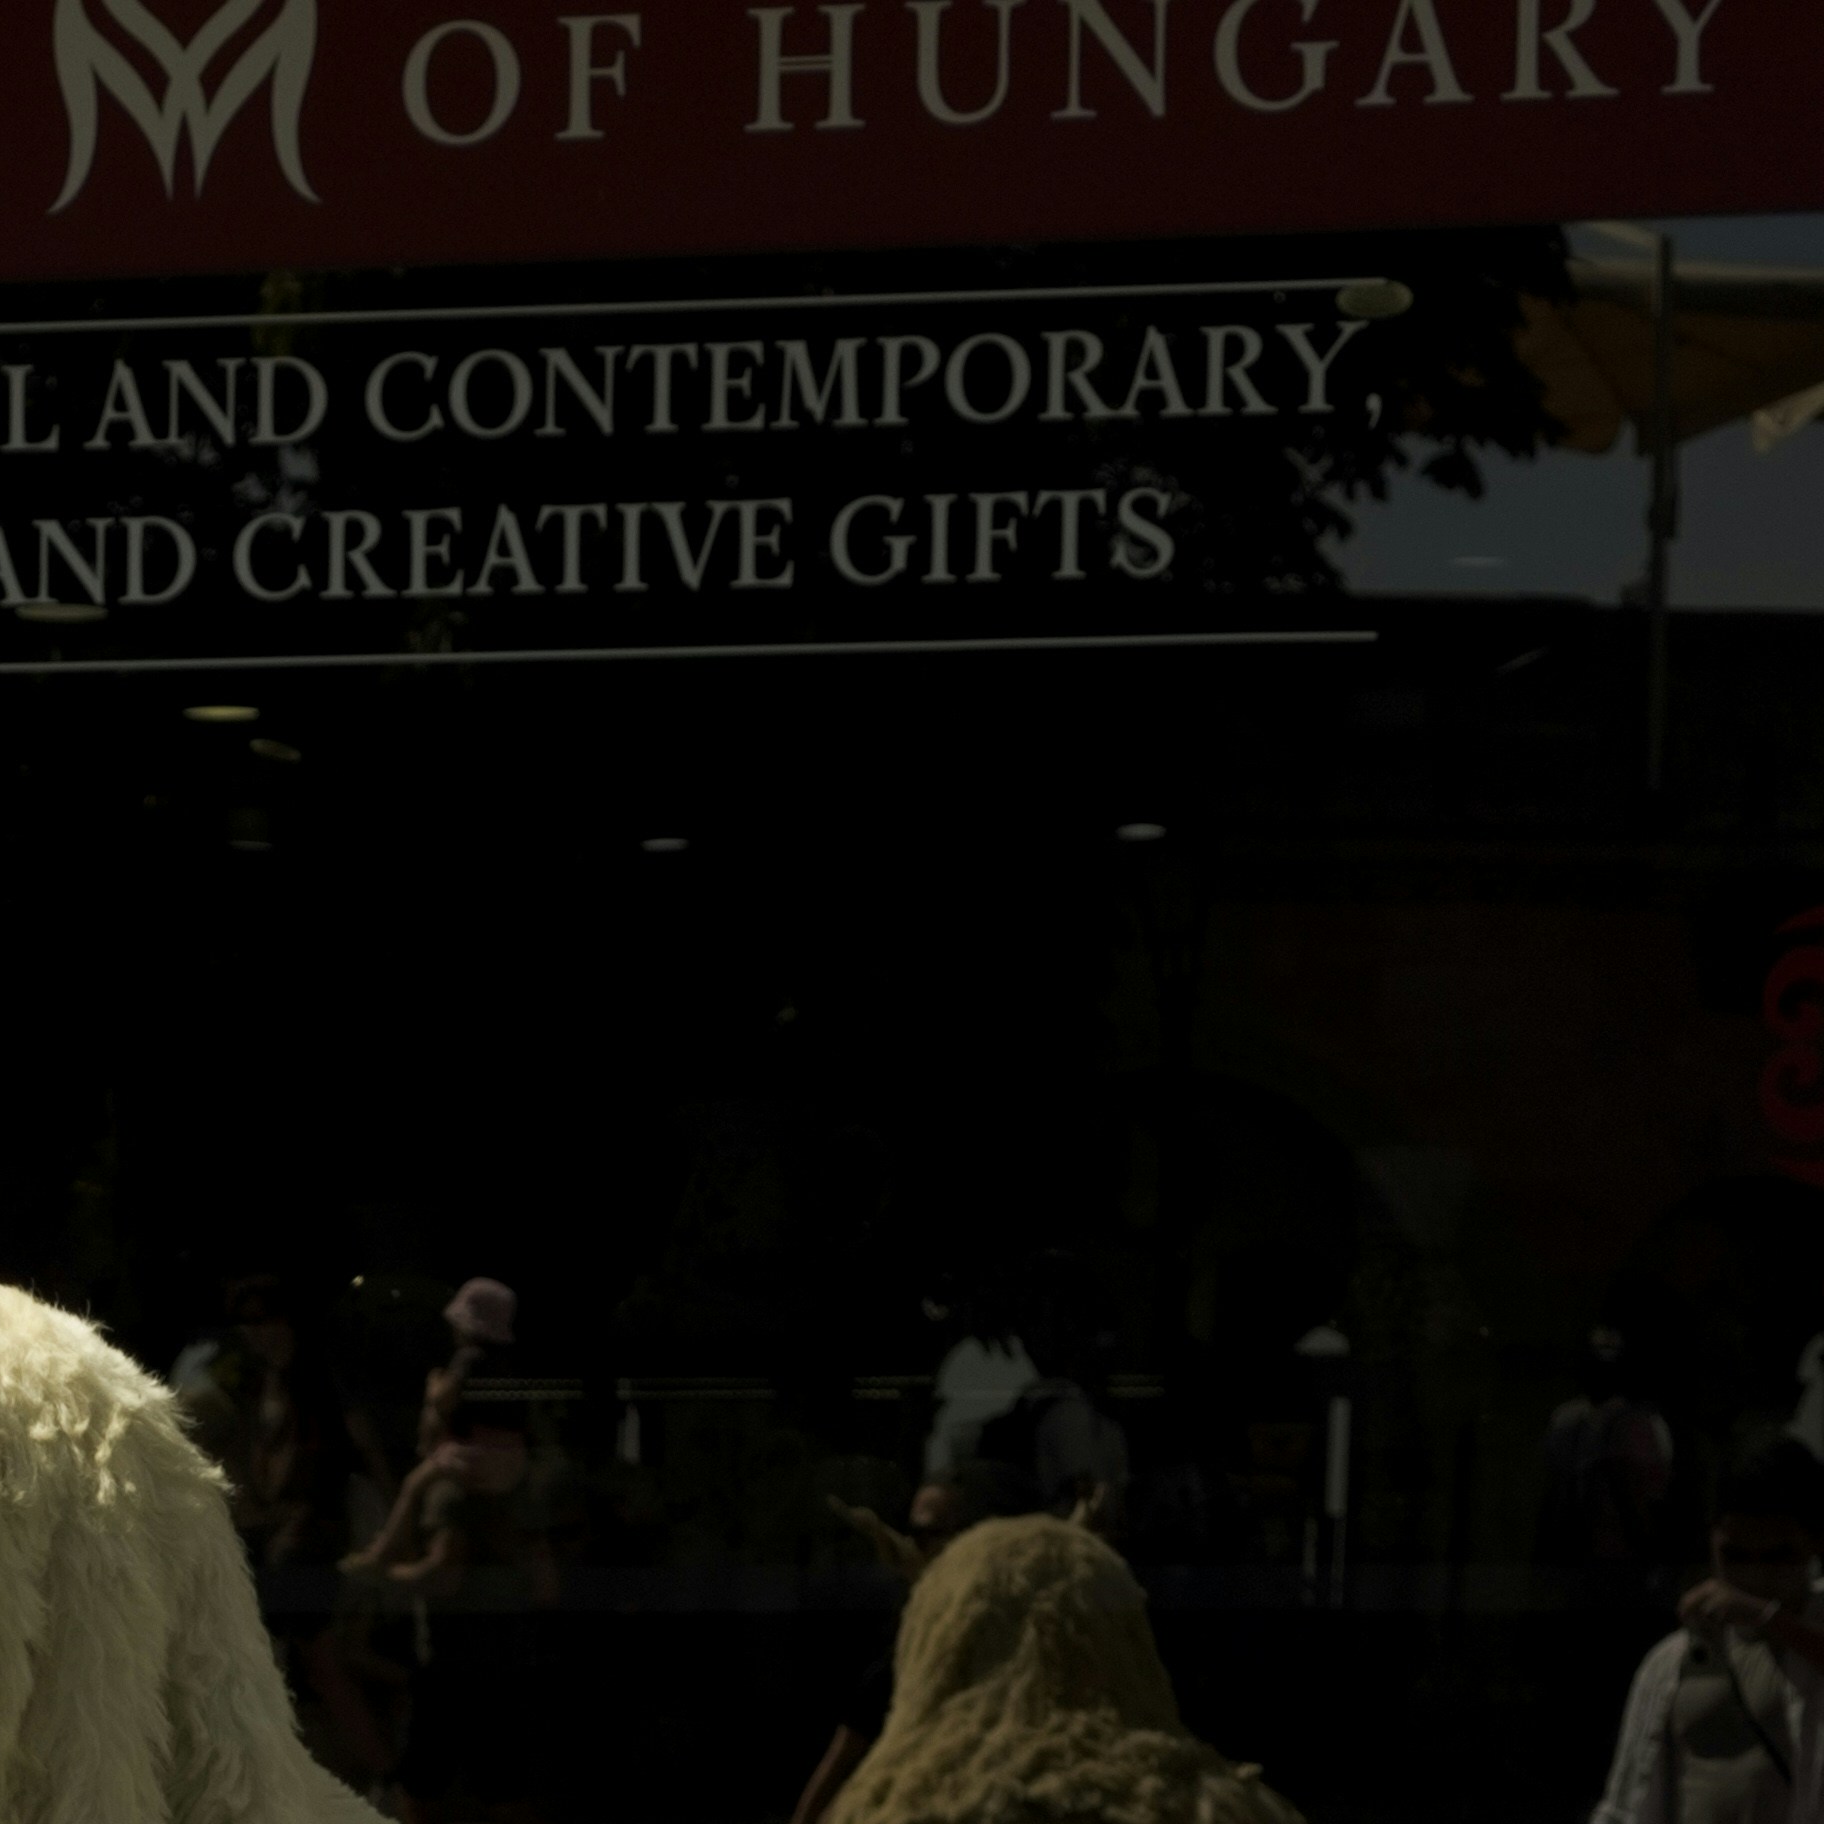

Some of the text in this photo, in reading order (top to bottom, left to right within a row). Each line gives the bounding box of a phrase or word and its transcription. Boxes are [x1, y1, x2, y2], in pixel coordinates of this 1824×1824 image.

[401, 12, 643, 149] OF
[744, 0, 1726, 133] HUNGARY
[82, 354, 330, 454] AND
[363, 319, 1383, 444] CONTEMPORARY,
[232, 496, 796, 600] CREATIVE
[828, 486, 1177, 585] GIFTS
